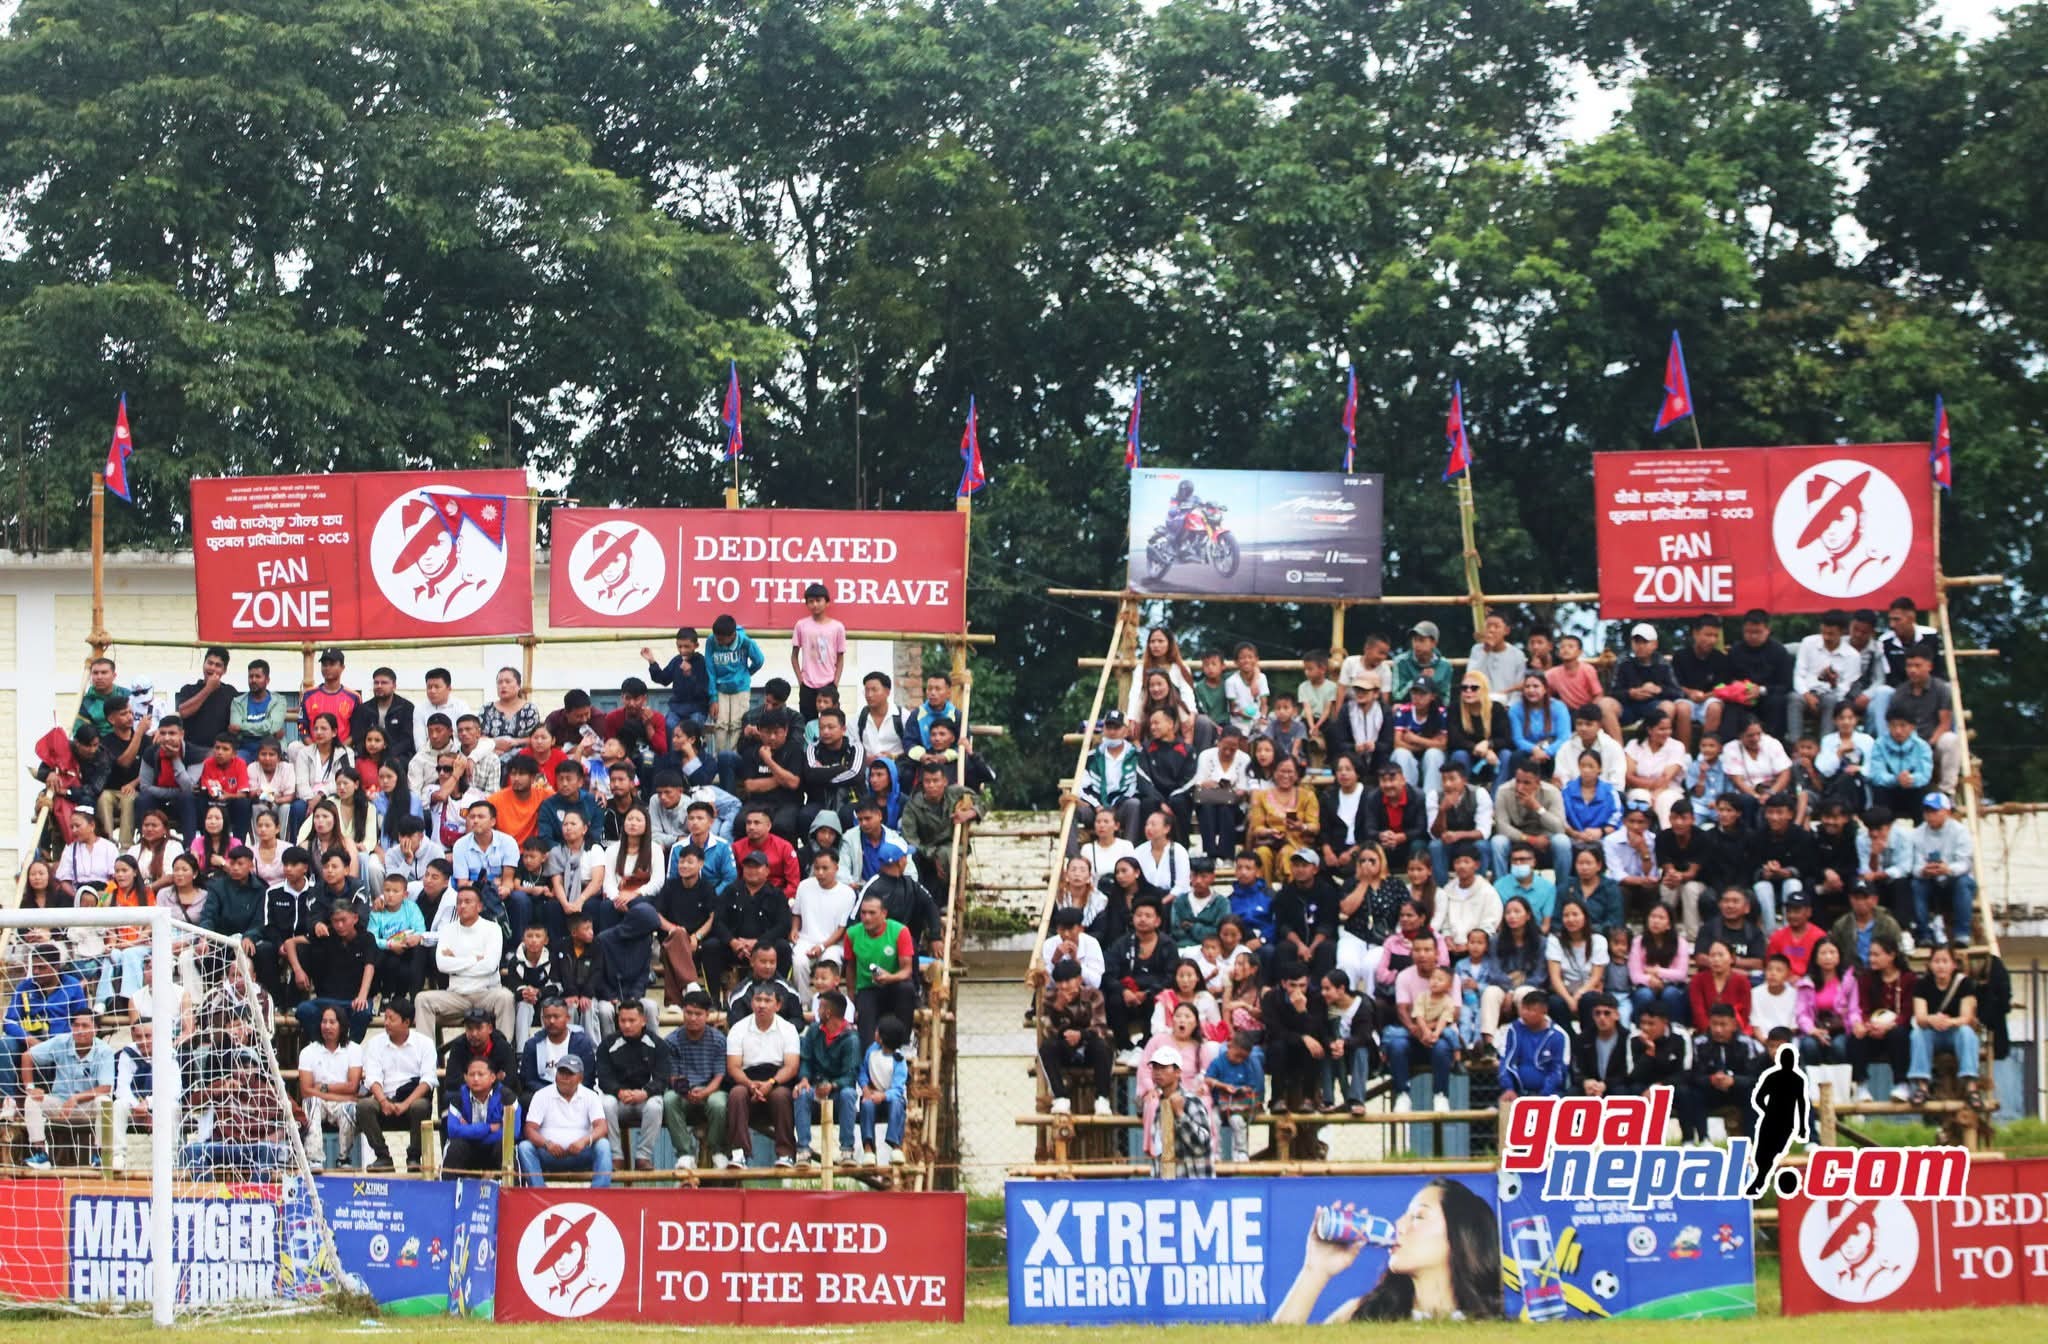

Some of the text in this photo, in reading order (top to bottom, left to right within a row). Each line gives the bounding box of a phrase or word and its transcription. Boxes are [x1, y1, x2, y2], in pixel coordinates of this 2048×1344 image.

[693, 536, 898, 563] DEDICATED
[1659, 531, 1712, 562] FAN
[257, 556, 309, 587] FAN
[1633, 565, 1733, 603] ZONE
[232, 590, 330, 629] ZONE
[693, 577, 740, 603] TO
[834, 579, 949, 606] BRAVE
[173, 1202, 276, 1262] TIGER
[657, 1221, 887, 1254] DEDICATED
[1022, 1198, 1264, 1266] XTREME
[1952, 1245, 2014, 1279] TO
[190, 1262, 275, 1302] DRINK
[656, 1271, 946, 1307] TO THE BRAVE
[1023, 1264, 1266, 1307] ENERGY DRINK
